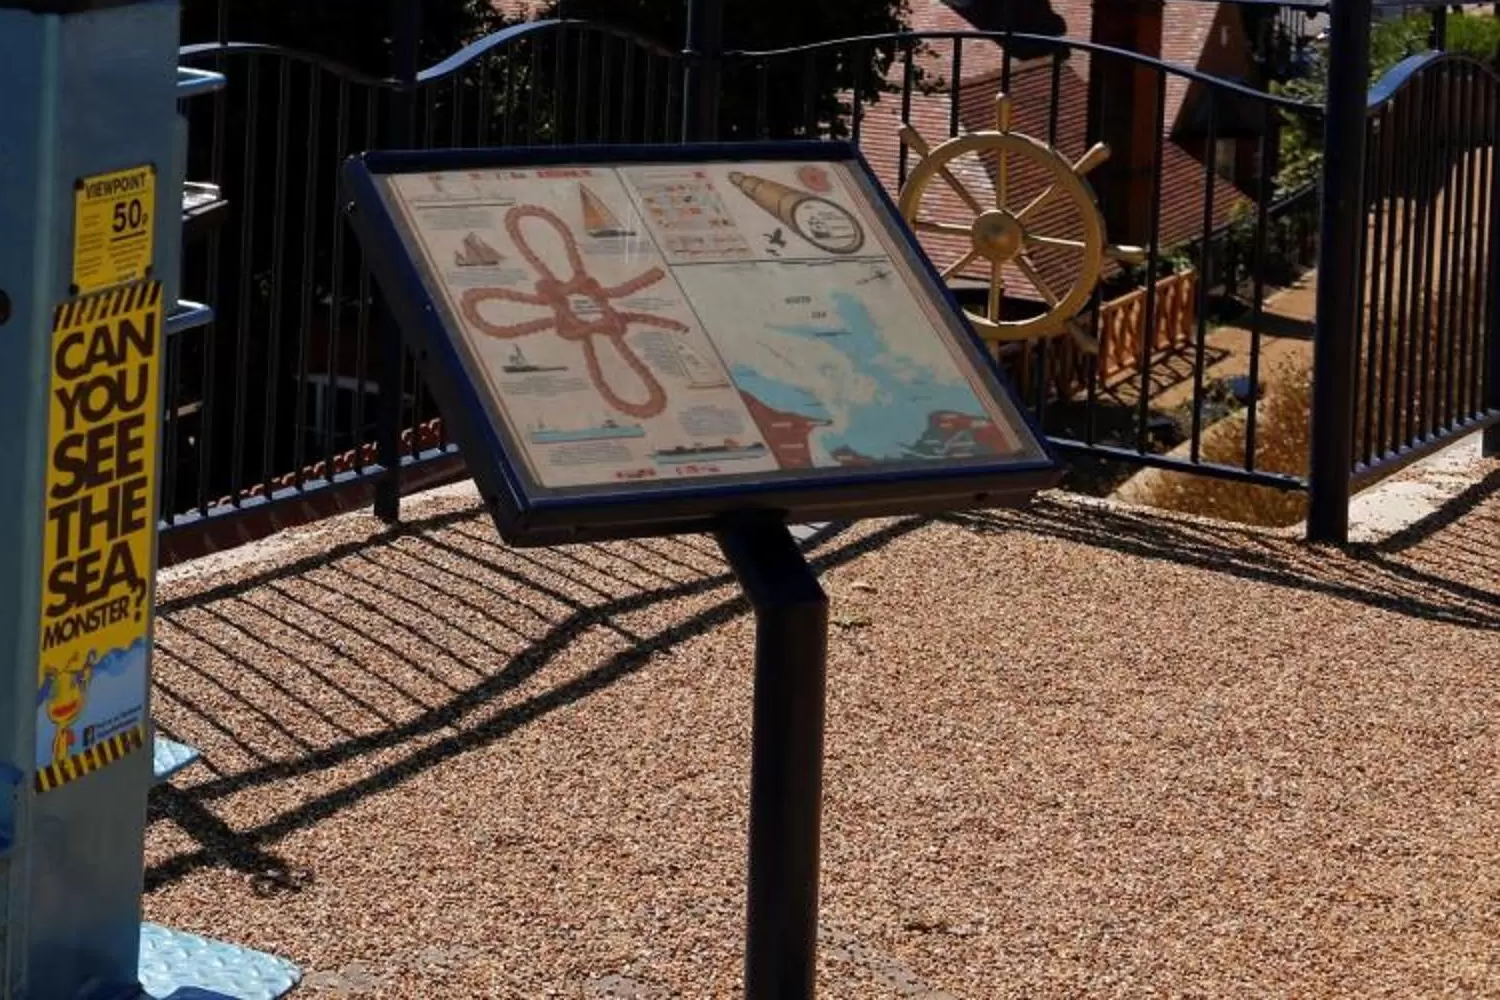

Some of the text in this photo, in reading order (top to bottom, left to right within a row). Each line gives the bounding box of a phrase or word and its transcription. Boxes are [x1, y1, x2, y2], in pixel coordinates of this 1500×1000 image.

[85, 172, 147, 200] VIEWPOINT
[56, 313, 153, 380] CAN
[55, 364, 148, 430] YOU
[50, 414, 145, 498] SEE
[49, 479, 146, 560] THE
[46, 541, 137, 617] SEA
